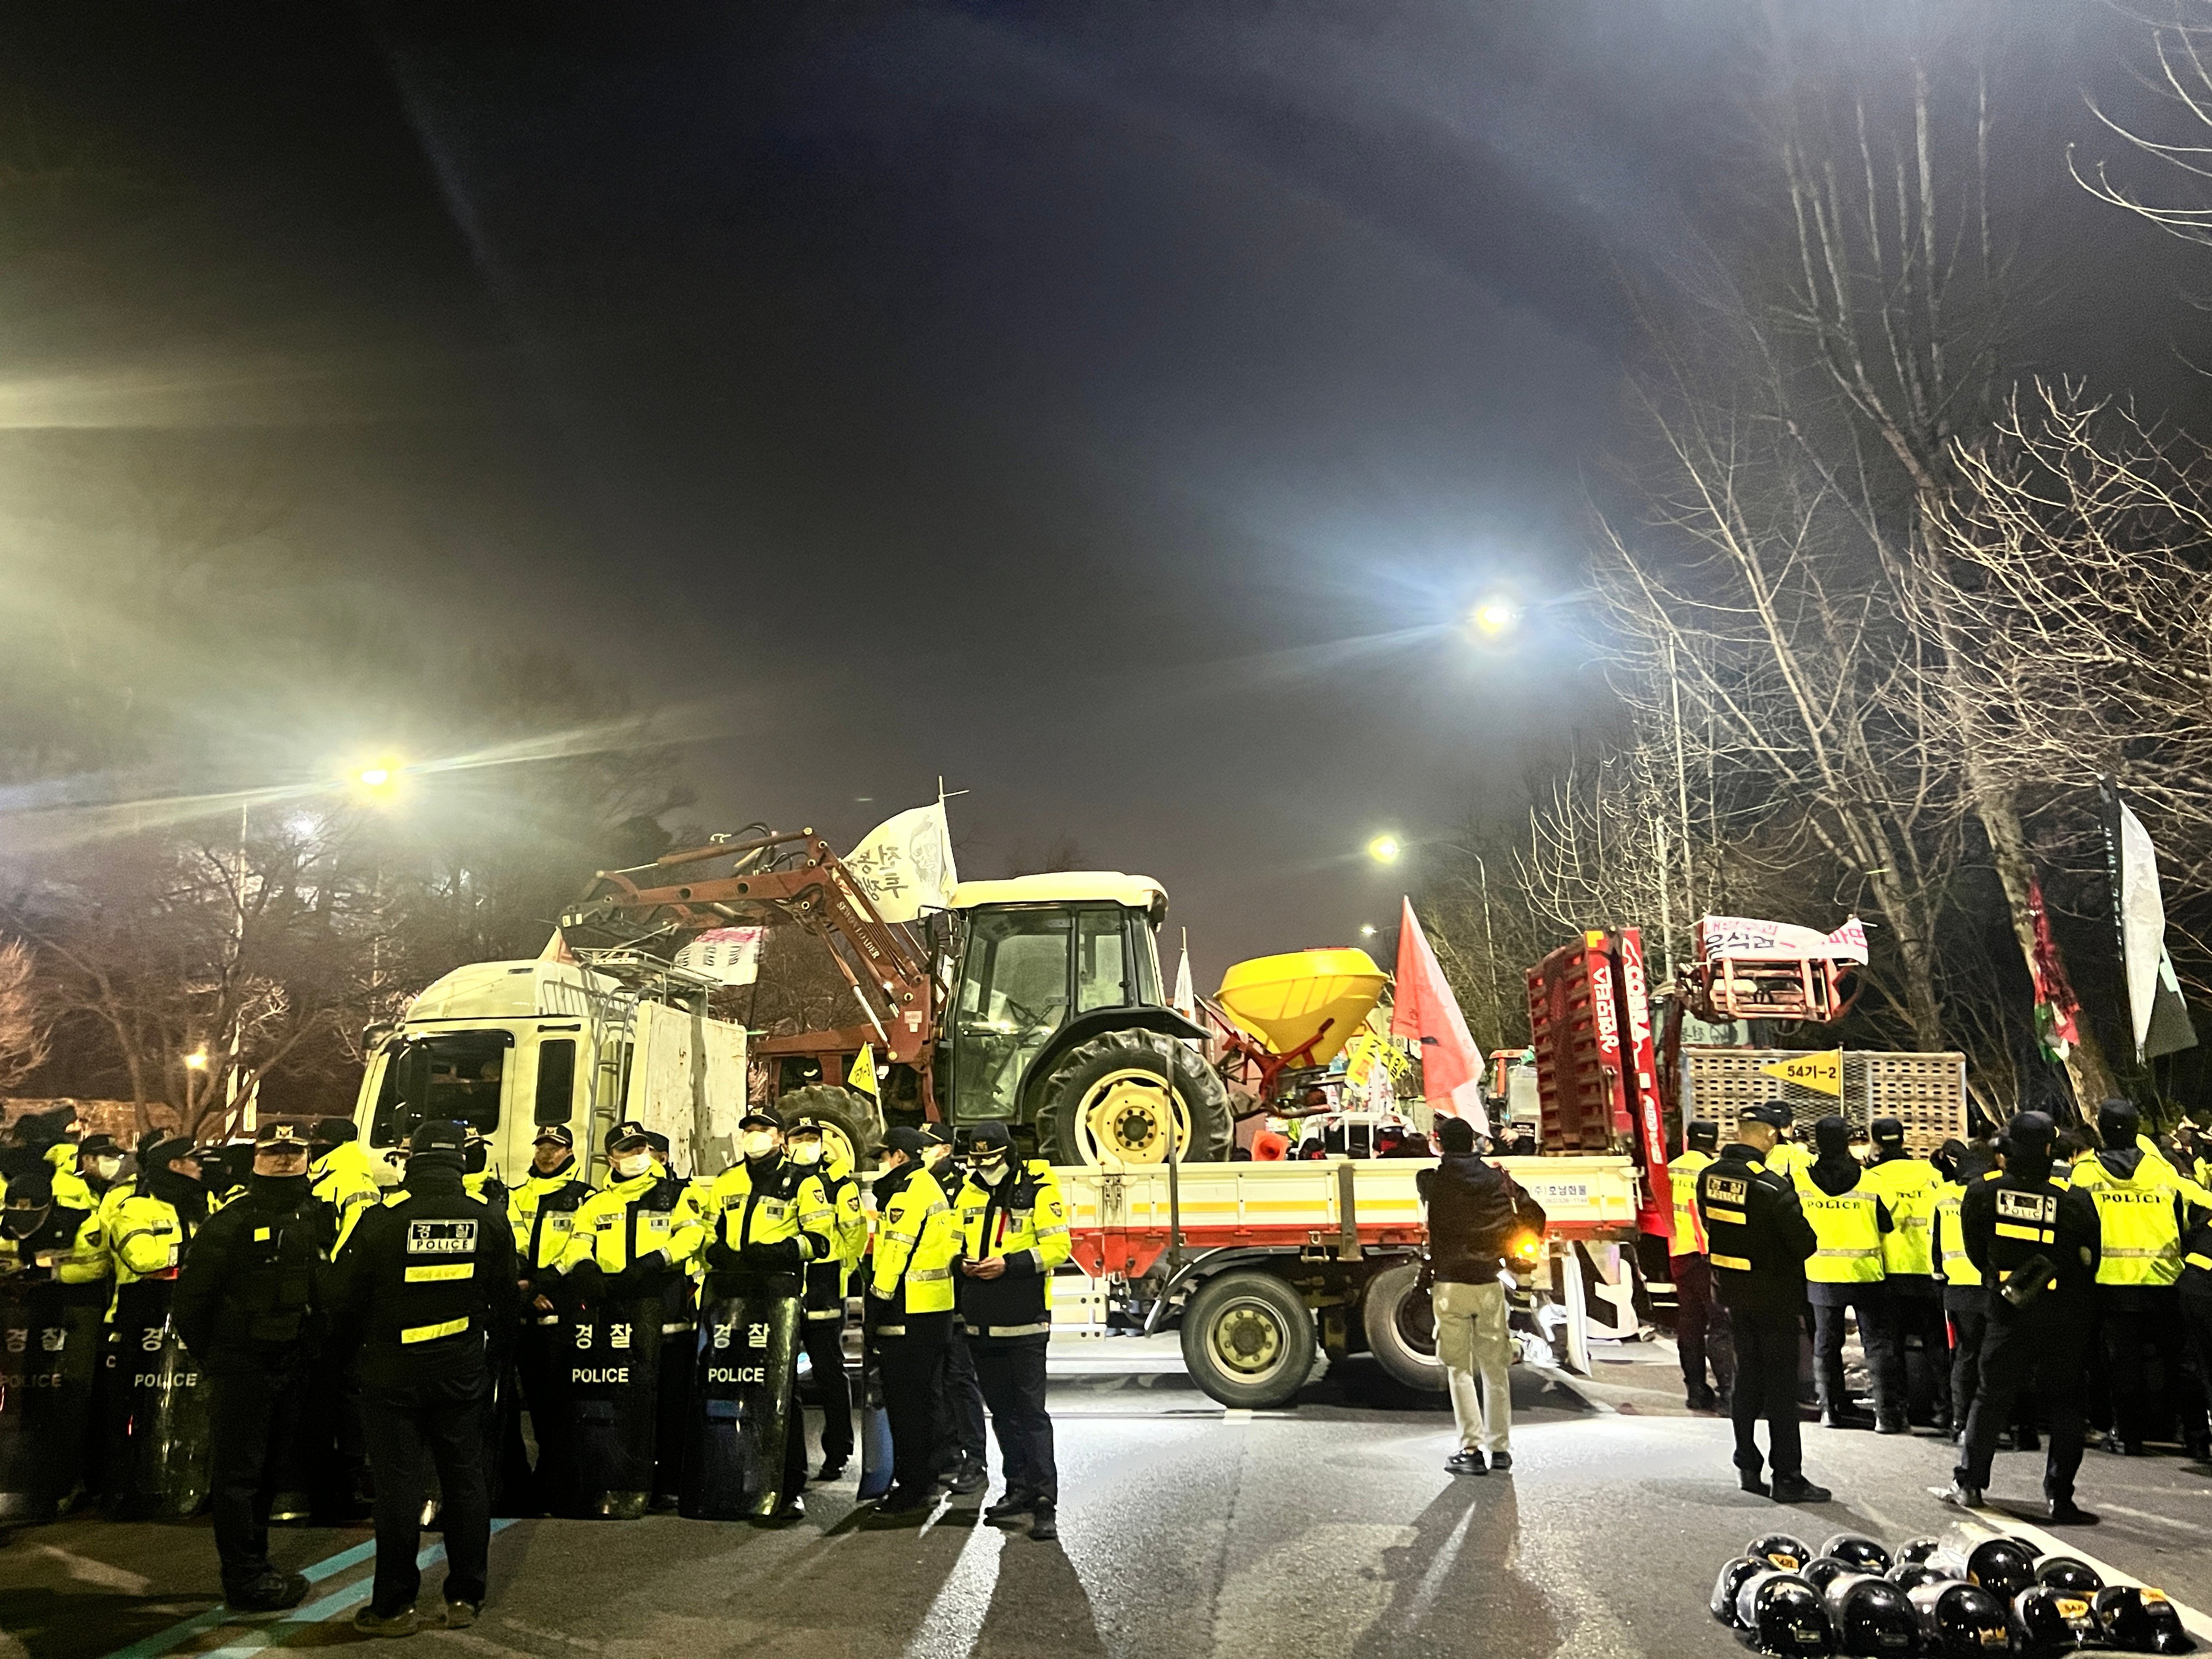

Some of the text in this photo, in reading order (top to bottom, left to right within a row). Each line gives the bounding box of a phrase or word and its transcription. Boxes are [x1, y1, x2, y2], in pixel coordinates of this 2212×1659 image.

[855, 927, 880, 959] LOADER
[1624, 966, 1651, 1042] COBRA
[1787, 1065, 1836, 1079] 54기-2
[416, 1240, 468, 1251] POLICE
[572, 1368, 629, 1383] POLICE
[708, 1367, 765, 1383] POLICE
